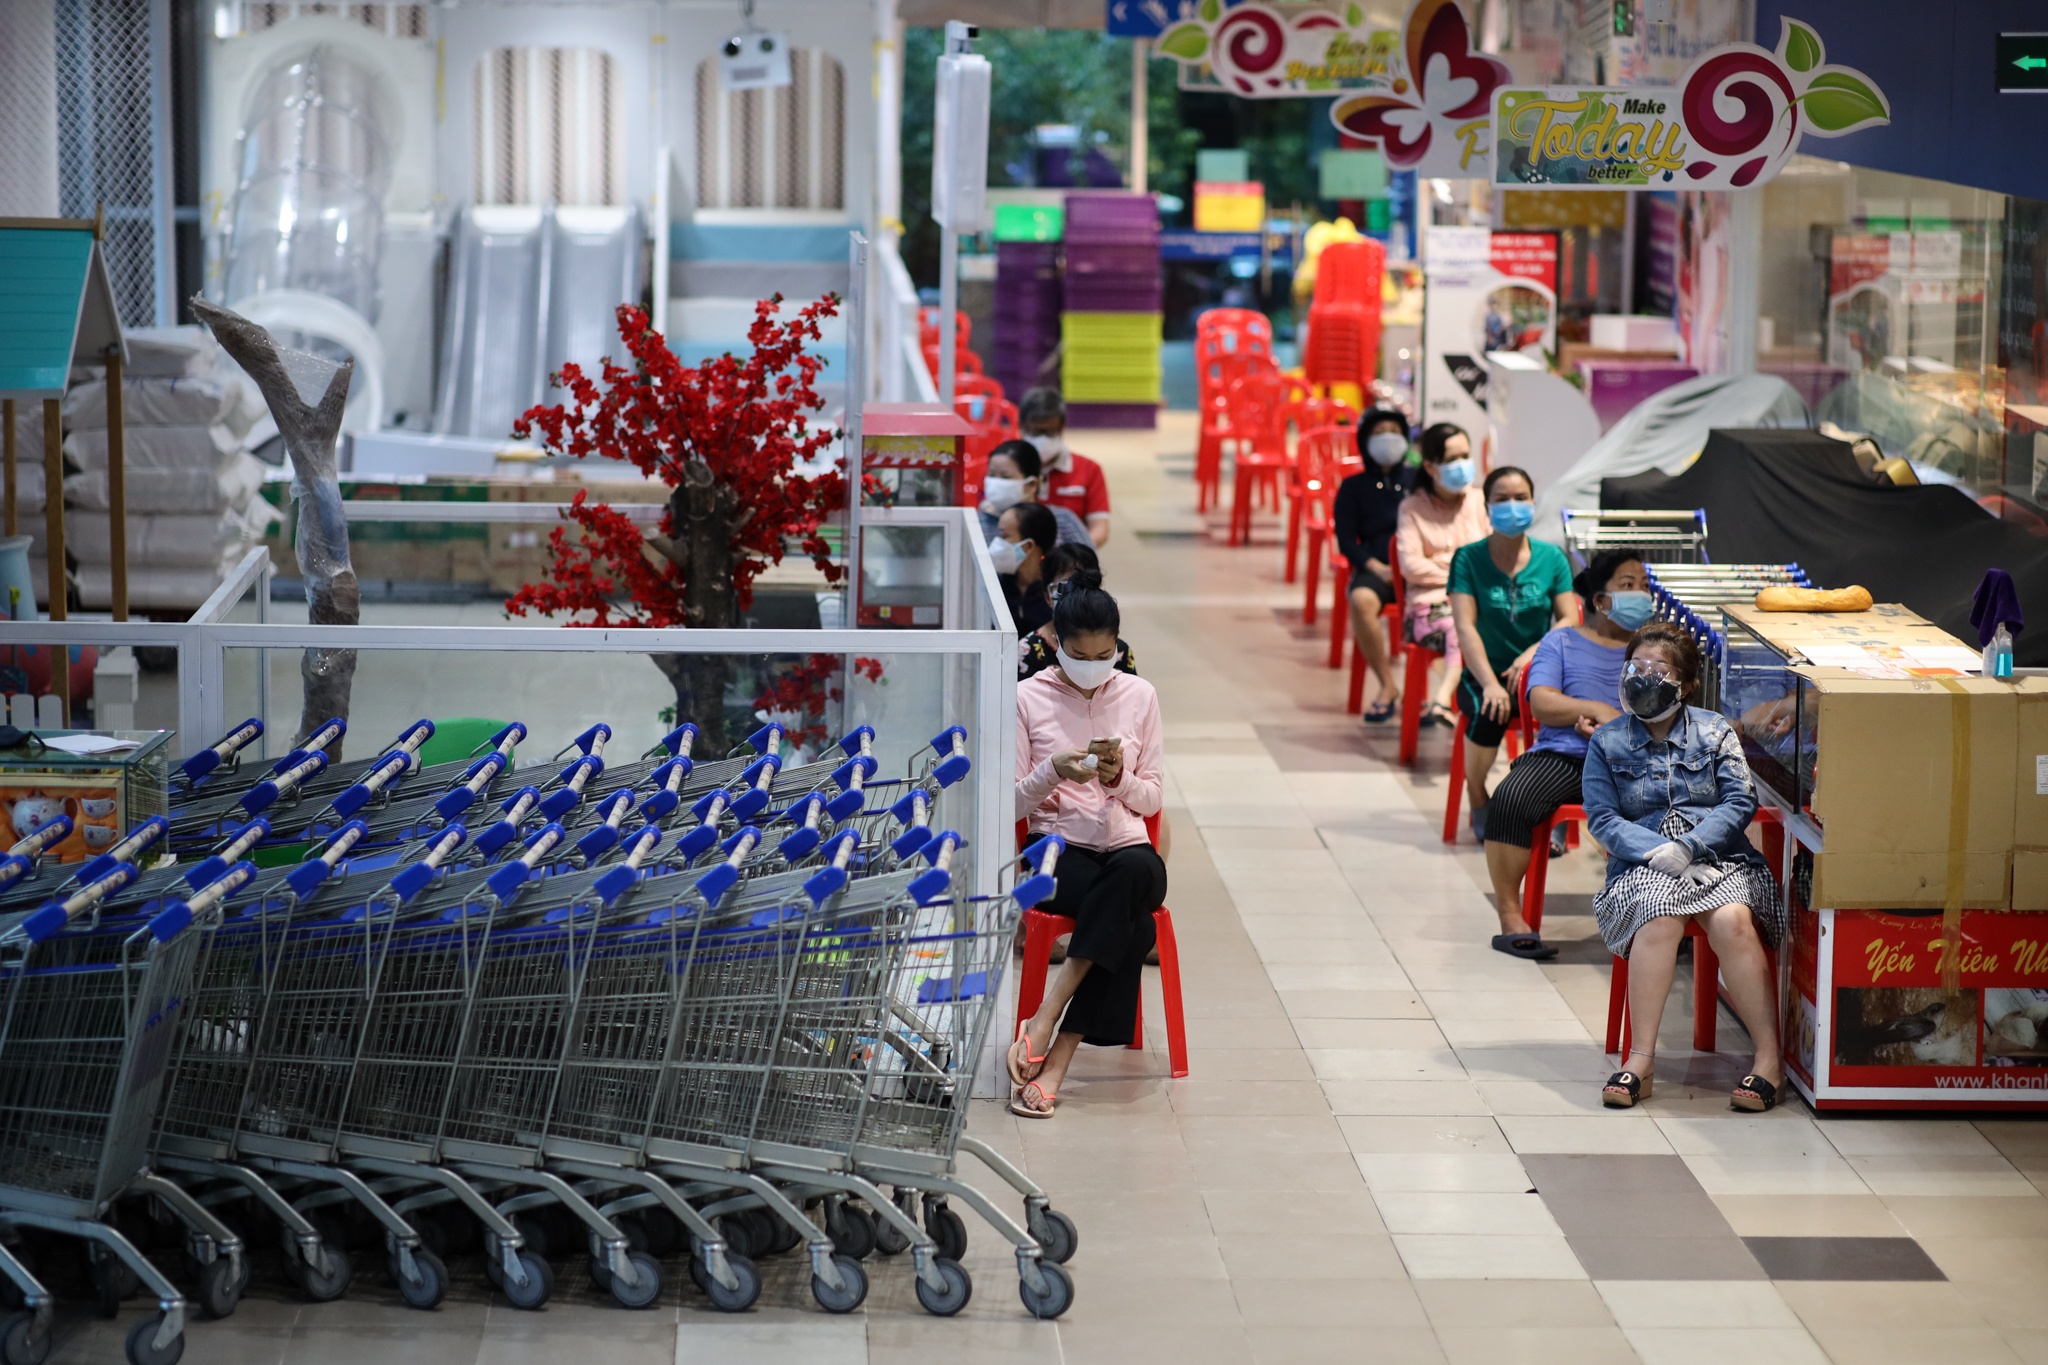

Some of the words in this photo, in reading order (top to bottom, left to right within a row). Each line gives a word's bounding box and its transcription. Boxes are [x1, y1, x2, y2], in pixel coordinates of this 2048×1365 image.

[1622, 98, 1667, 115] Make
[1509, 97, 1688, 176] Today
[1587, 164, 1634, 180] better
[1865, 937, 1916, 984] Yến
[1926, 938, 1999, 975] Thiên
